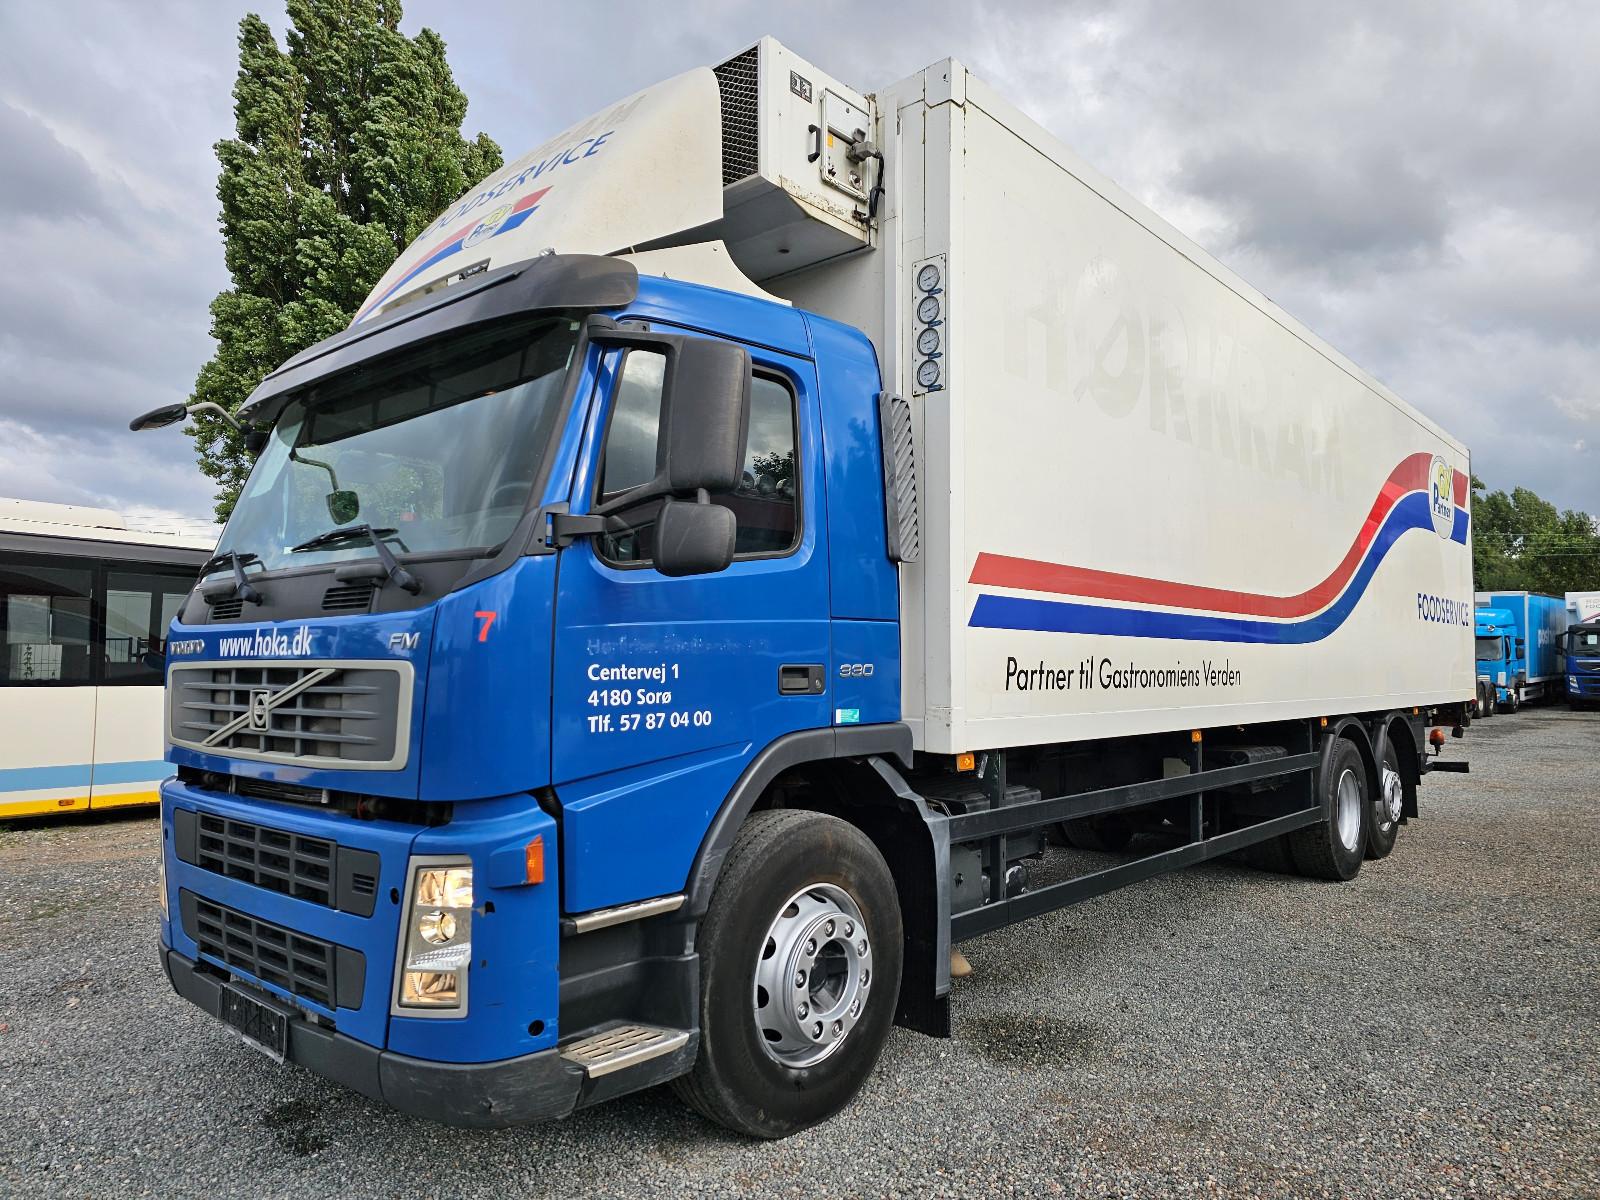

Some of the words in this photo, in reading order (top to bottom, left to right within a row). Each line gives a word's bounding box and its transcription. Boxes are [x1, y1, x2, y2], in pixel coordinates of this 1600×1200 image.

[420, 131, 615, 241] OODSERVICE
[1417, 592, 1469, 627] FOODSERVICE
[219, 625, 313, 657] www.hoka.dk
[388, 632, 421, 650] FM
[475, 612, 497, 642] 7
[587, 663, 666, 684] Centervej
[671, 663, 680, 679] 1
[1005, 656, 1075, 691] Partner
[1079, 656, 1094, 690] til
[1099, 657, 1200, 690] Gastronomiens
[1202, 659, 1241, 686] Verden
[587, 689, 632, 707] 4180
[636, 688, 672, 705] Sorø
[587, 714, 615, 733] Tlf.
[620, 713, 641, 732] 57
[645, 712, 666, 730] 87
[669, 711, 690, 728] 04
[693, 710, 712, 727] 00
